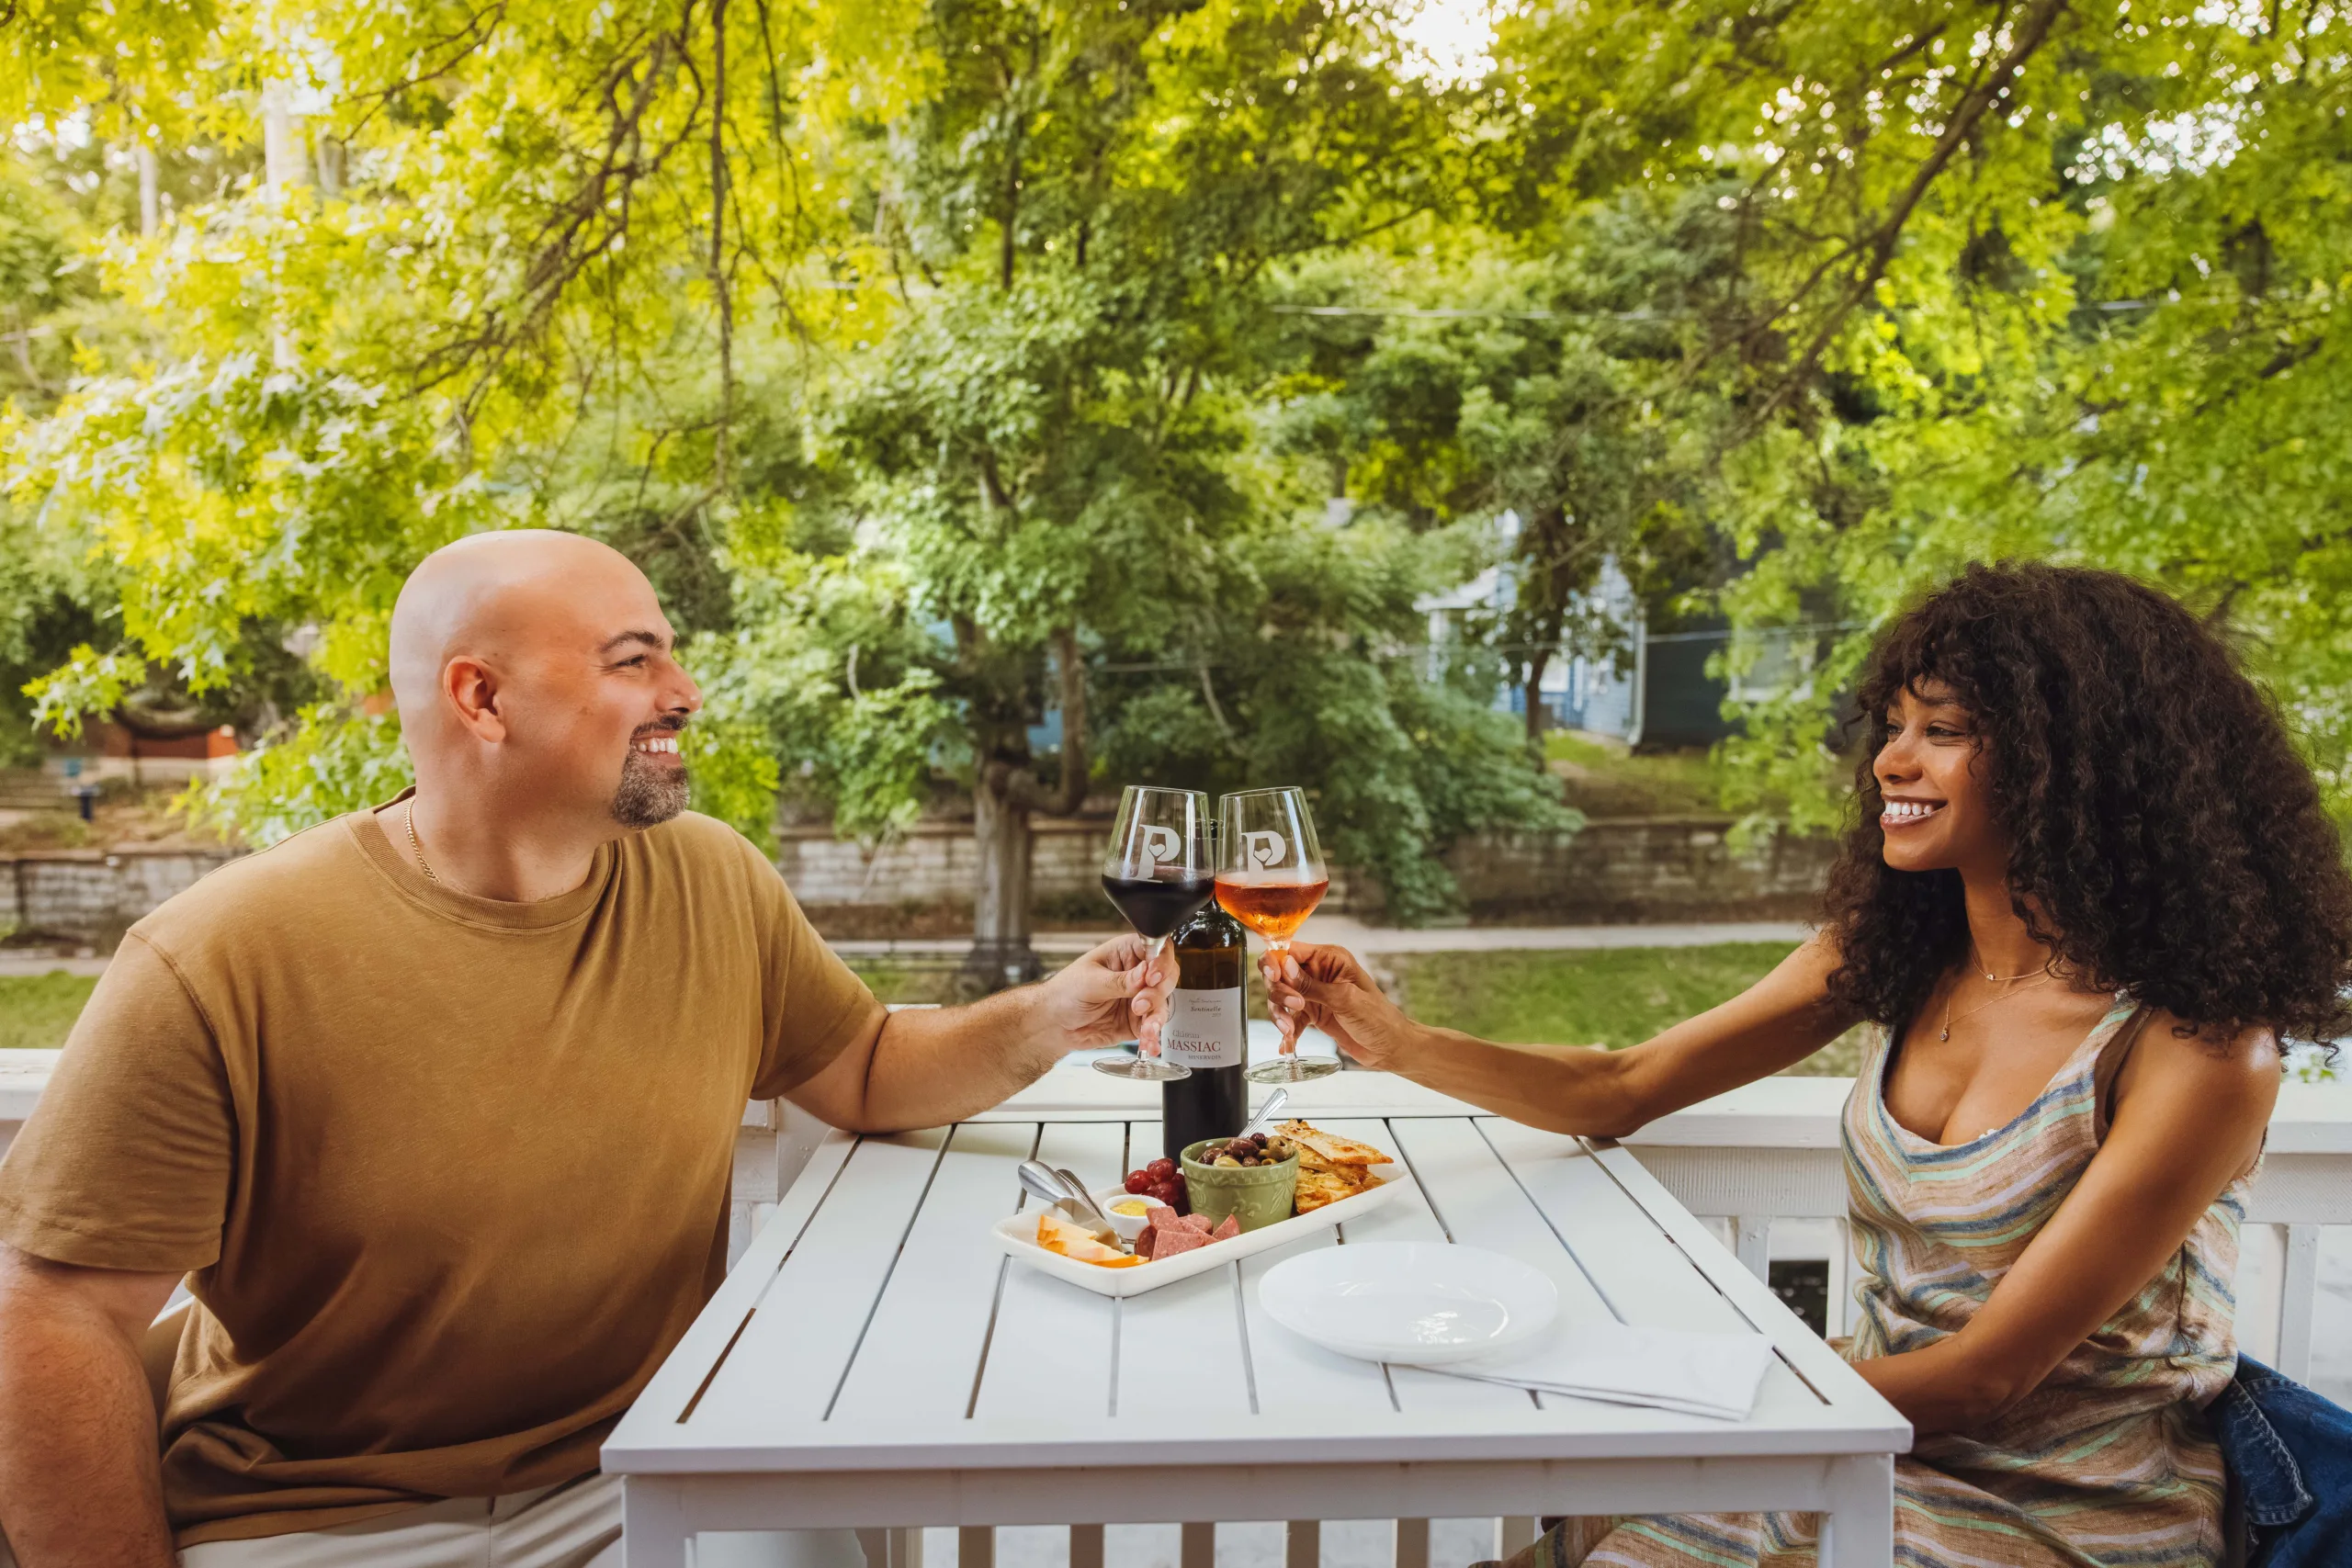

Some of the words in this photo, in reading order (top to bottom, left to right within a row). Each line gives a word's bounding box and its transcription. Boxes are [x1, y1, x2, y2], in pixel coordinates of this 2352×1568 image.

[1131, 824, 1182, 884] P
[1240, 830, 1286, 884] P
[1167, 1037, 1221, 1052] MASSIAC
